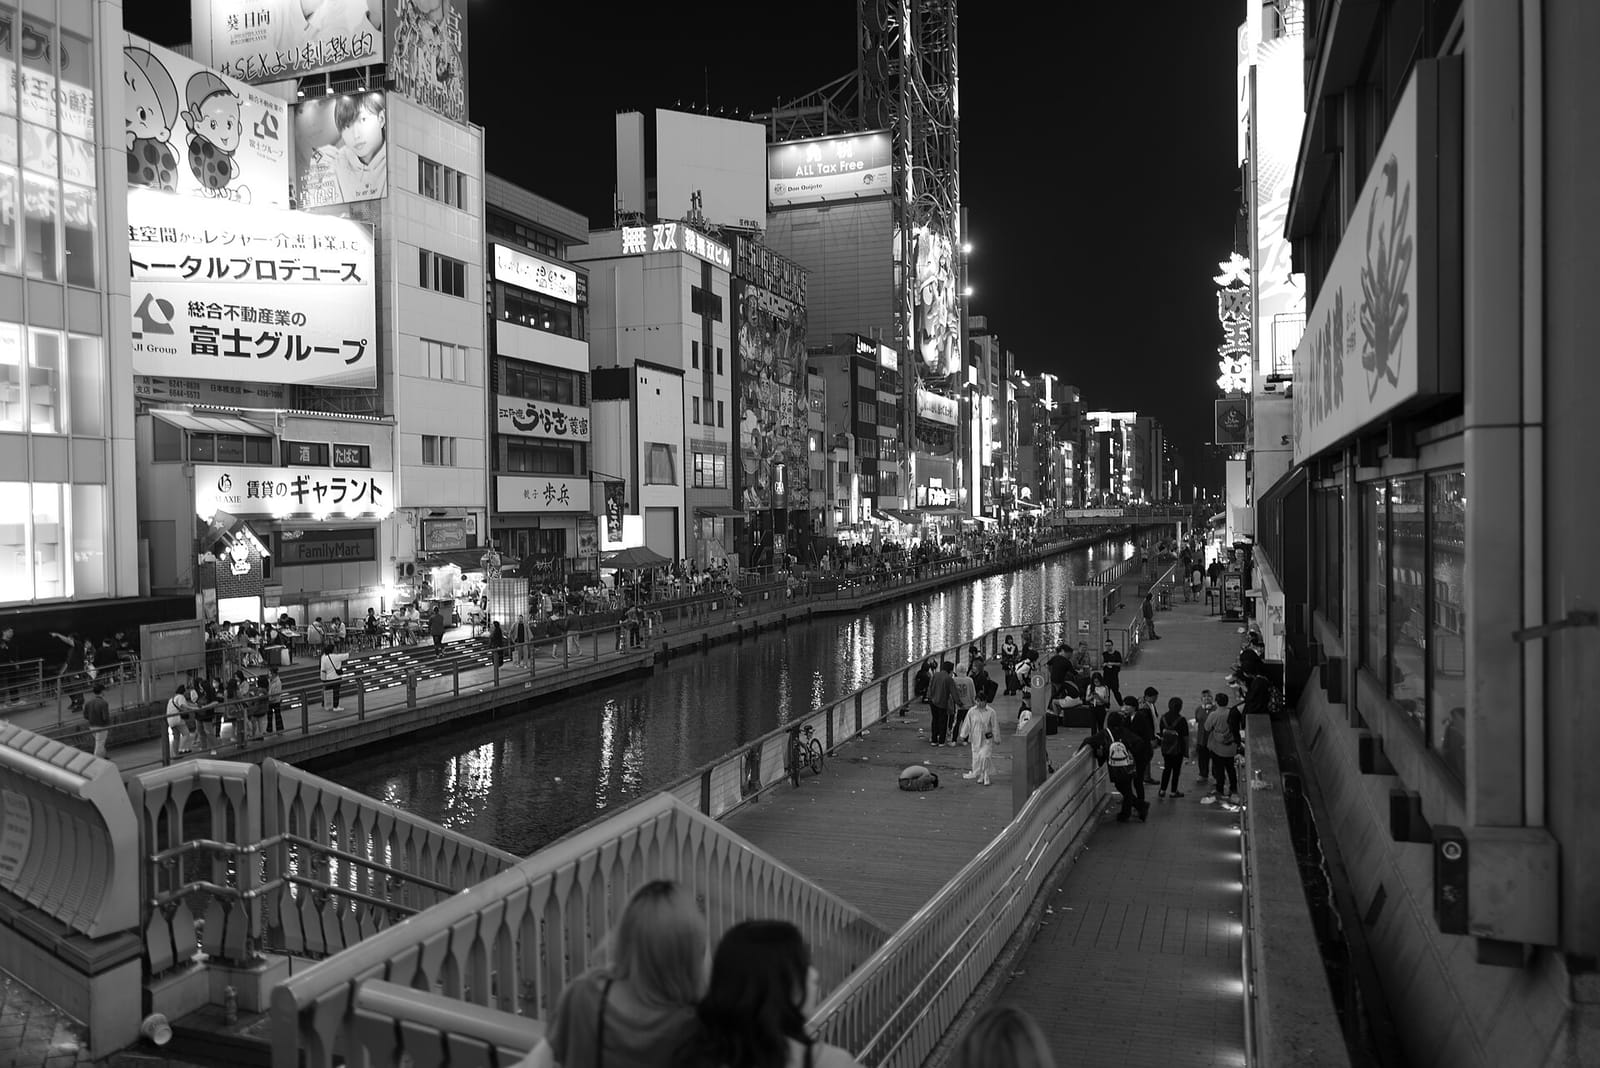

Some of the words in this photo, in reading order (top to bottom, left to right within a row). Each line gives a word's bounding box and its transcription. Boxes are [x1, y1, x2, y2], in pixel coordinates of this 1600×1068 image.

[795, 165, 814, 177] ALL
[817, 163, 837, 174] Tax
[840, 160, 864, 172] Free
[130, 253, 362, 282] トータルプロデュース
[187, 300, 307, 327] 総合不動産業の
[146, 344, 177, 355] Group
[189, 325, 368, 365] 富士グループ
[299, 446, 310, 462] 酒
[336, 448, 359, 463] たばこ
[298, 542, 360, 559] FamilyMart
